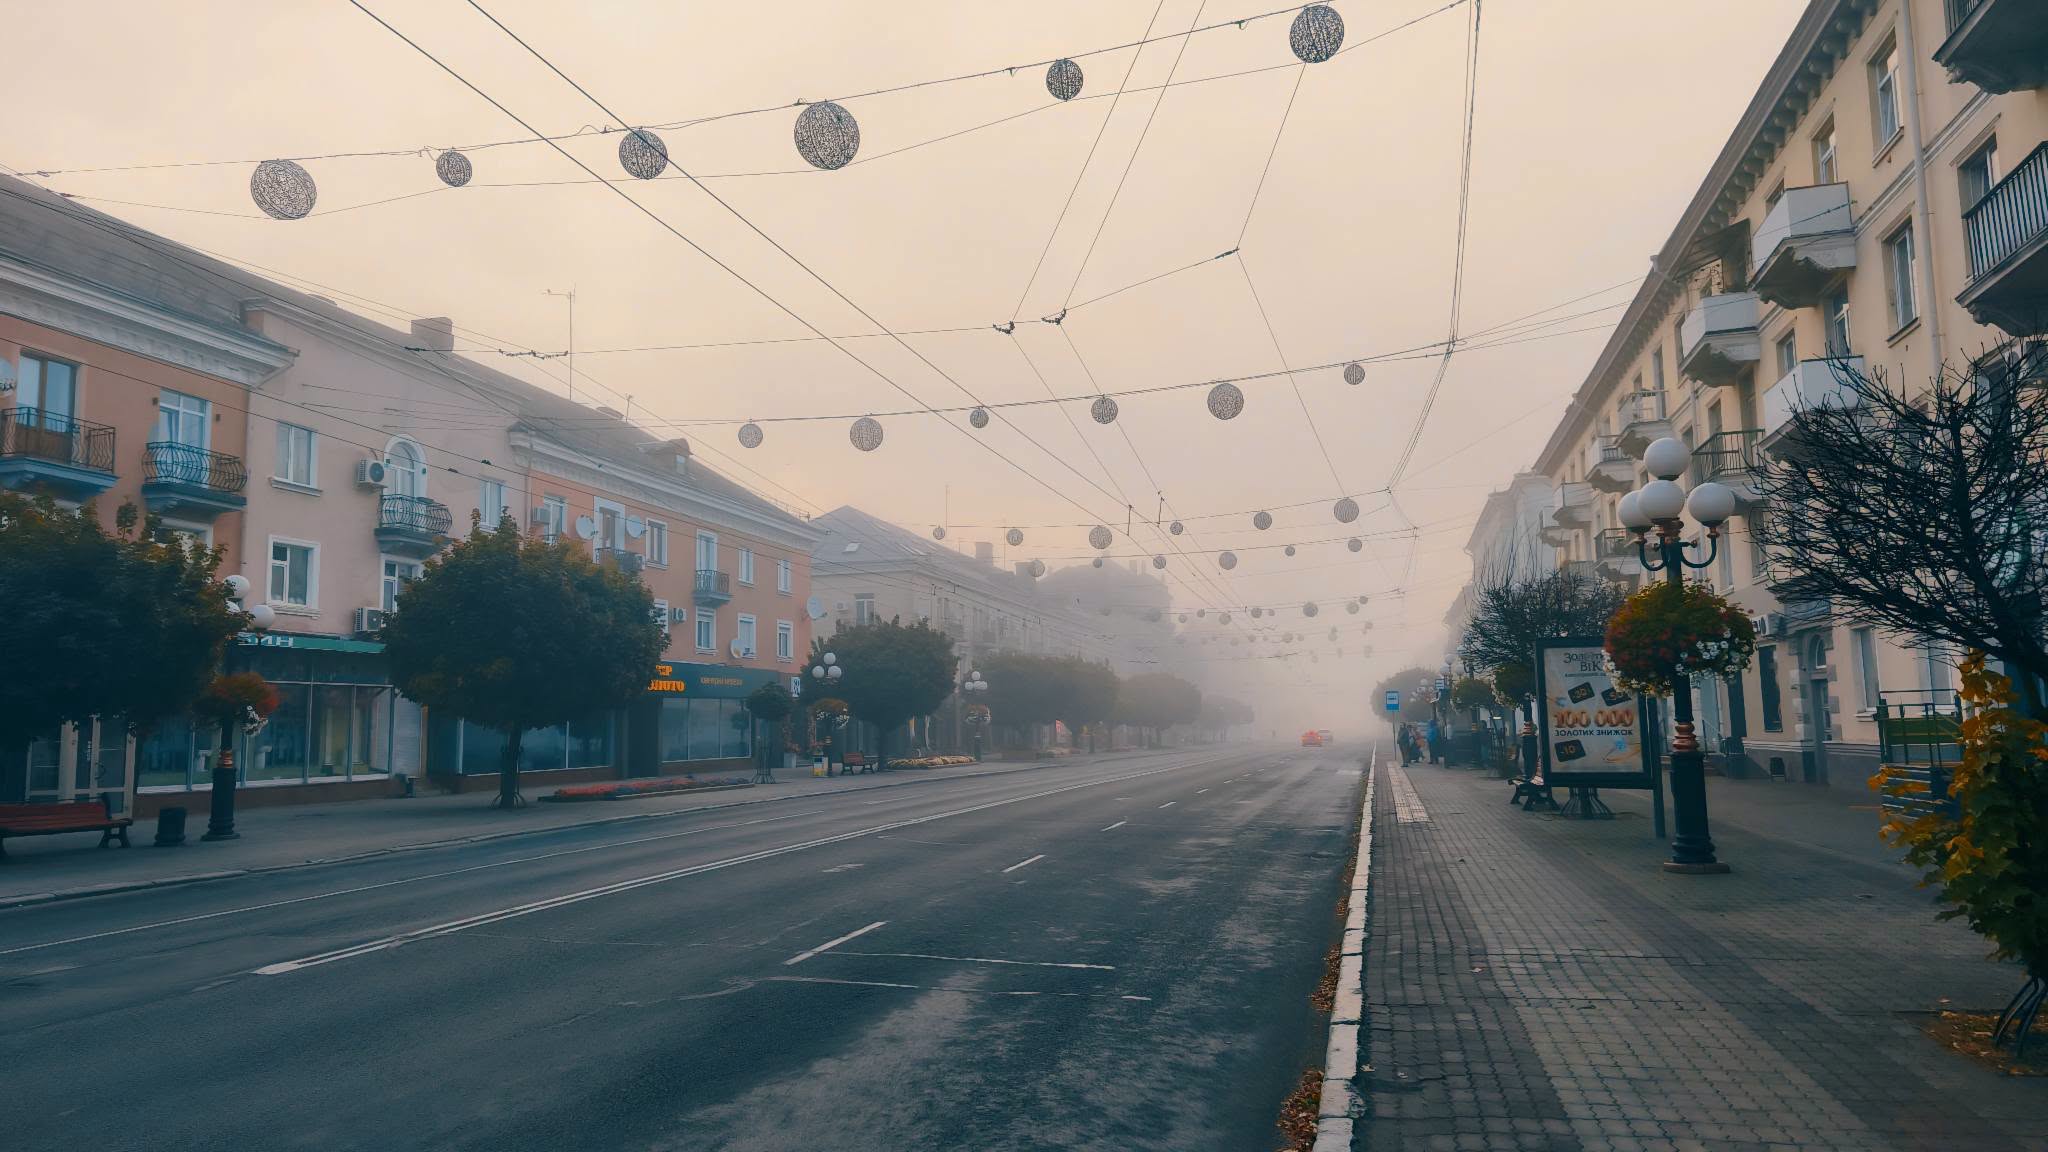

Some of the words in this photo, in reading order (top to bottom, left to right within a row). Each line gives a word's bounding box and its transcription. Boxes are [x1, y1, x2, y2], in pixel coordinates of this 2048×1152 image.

[1554, 709, 1591, 728] 100
[1594, 708, 1634, 728] 000
[1554, 729, 1594, 737] ЗОЛОТИХ
